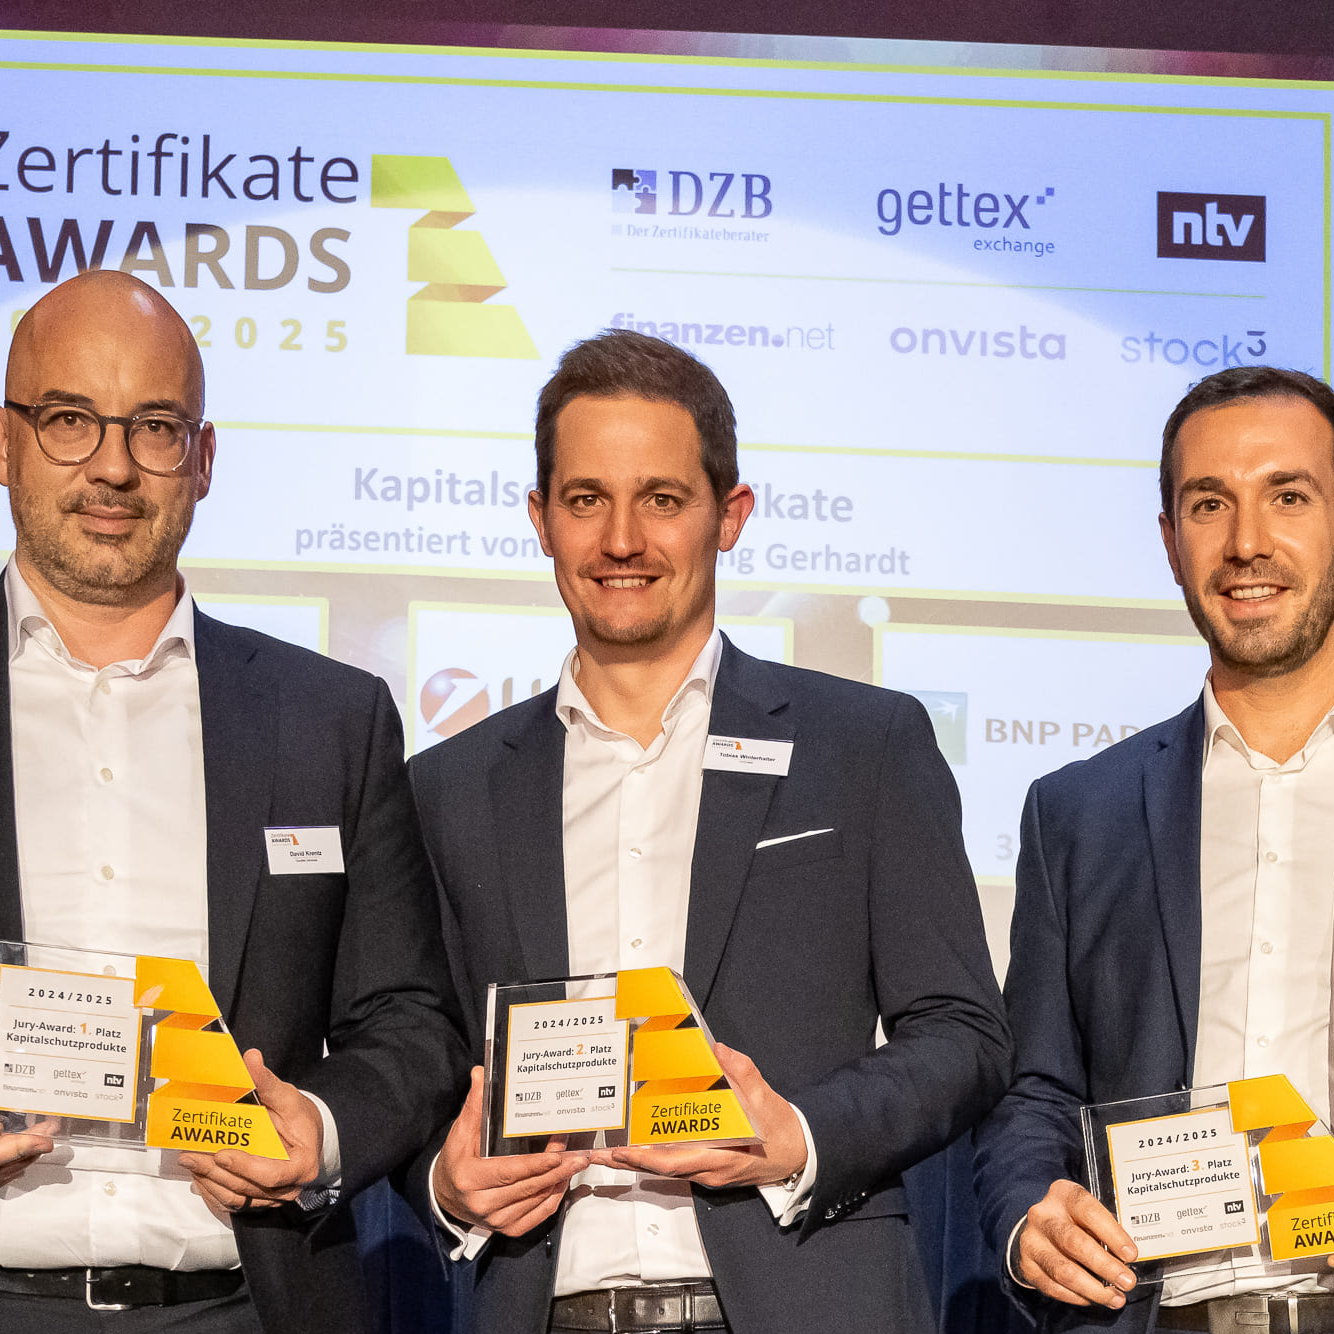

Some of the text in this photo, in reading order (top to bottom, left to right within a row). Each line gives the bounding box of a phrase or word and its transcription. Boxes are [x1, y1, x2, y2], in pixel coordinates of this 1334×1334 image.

[668, 170, 773, 219] DZB
[876, 182, 1031, 236] gettex
[626, 224, 770, 242] Der Zertifikateberater
[1172, 201, 1255, 247] ntv
[973, 236, 1055, 258] exchange
[889, 324, 1067, 361] onvista
[295, 522, 471, 556] präsentiert
[480, 535, 539, 558] von
[765, 542, 911, 576] Gerhardt
[985, 718, 1061, 746] BNP
[28, 988, 112, 1005] 2024/2025
[13, 1019, 76, 1034] Jury-Award:
[95, 1027, 121, 1039] Platz
[534, 1015, 604, 1030] 2024/2025
[6, 1032, 127, 1053] Kapitalschutzprodukte
[522, 1048, 575, 1062] Jury-Award:
[590, 1045, 612, 1055] Platz
[14, 1063, 36, 1075] DZB
[517, 1057, 617, 1075] Kapitalschutzprodukte
[524, 1091, 542, 1101] DZB
[172, 1107, 253, 1129] Zertifikate
[650, 1101, 722, 1119] Zertifikate
[170, 1125, 251, 1147] AWARDS
[650, 1117, 720, 1136] AWARDS
[1138, 1128, 1217, 1149] 2024/2025
[1131, 1164, 1190, 1183] Jury-Award:
[1207, 1159, 1233, 1170] Platz
[1127, 1171, 1240, 1196] Kapitalschutzprodukte
[1140, 1212, 1161, 1224] DZB
